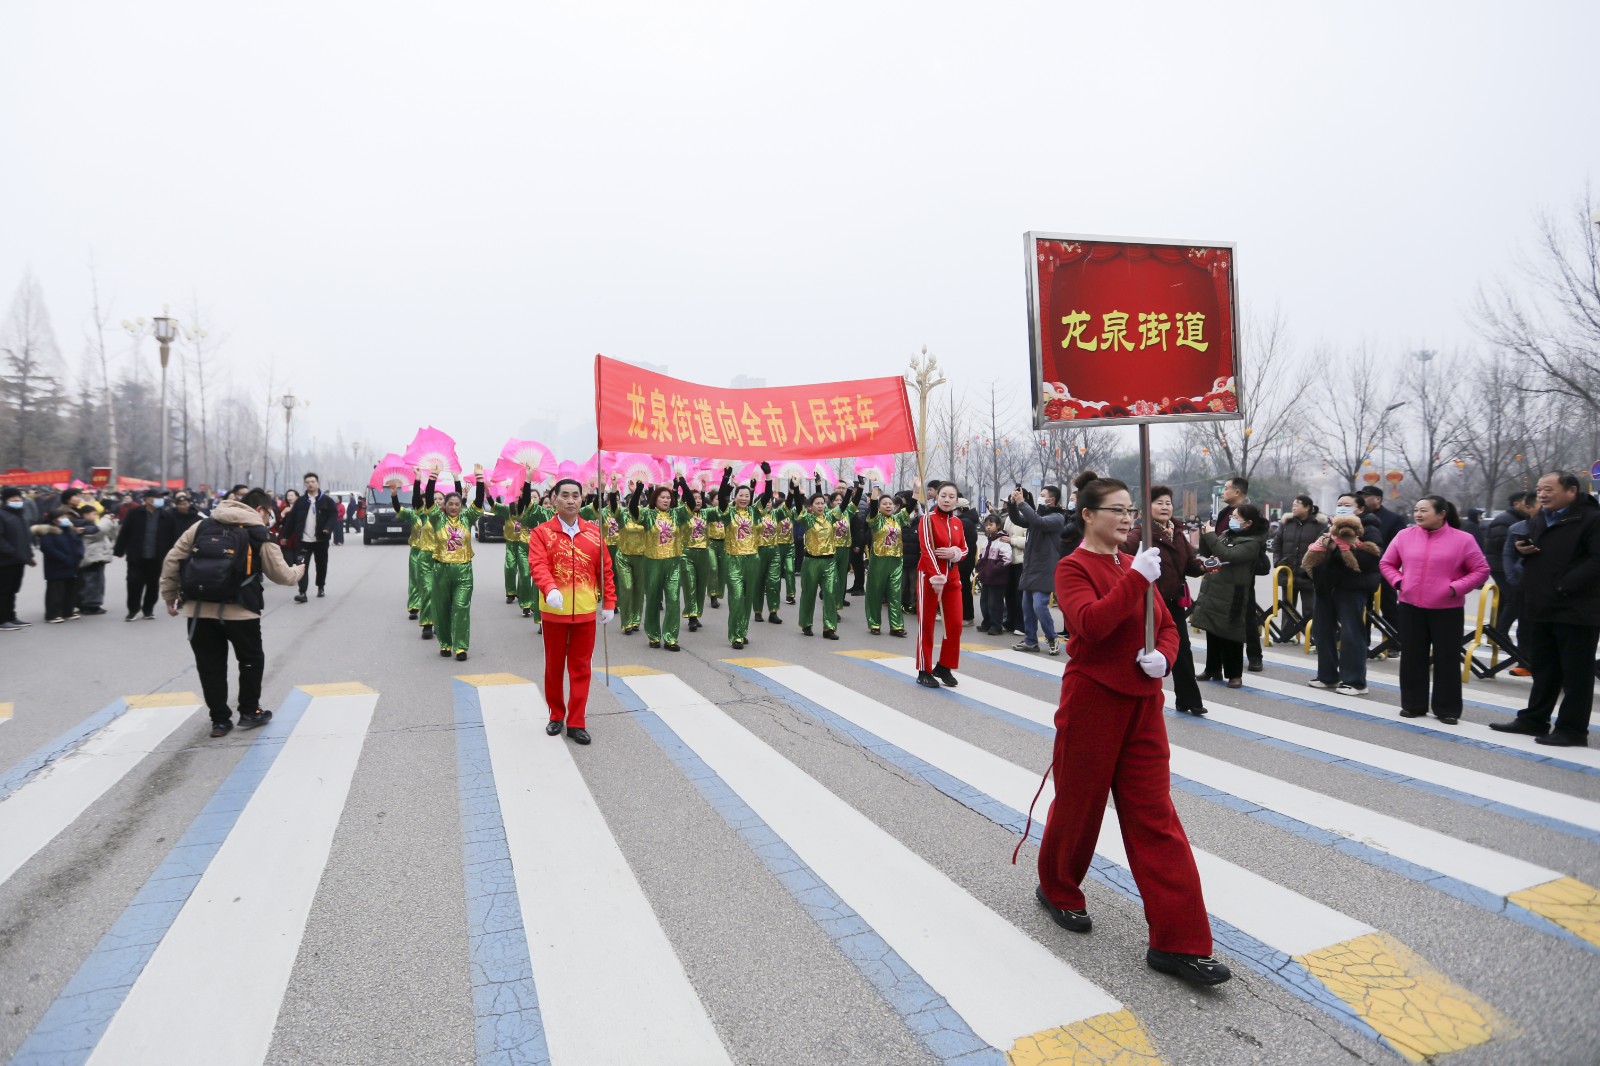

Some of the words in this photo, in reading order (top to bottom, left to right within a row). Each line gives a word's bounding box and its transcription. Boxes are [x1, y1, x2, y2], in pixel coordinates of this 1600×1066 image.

[1061, 309, 1209, 352] 龙泉街道
[626, 382, 880, 447] 龙泉街道向全市人民拜年
